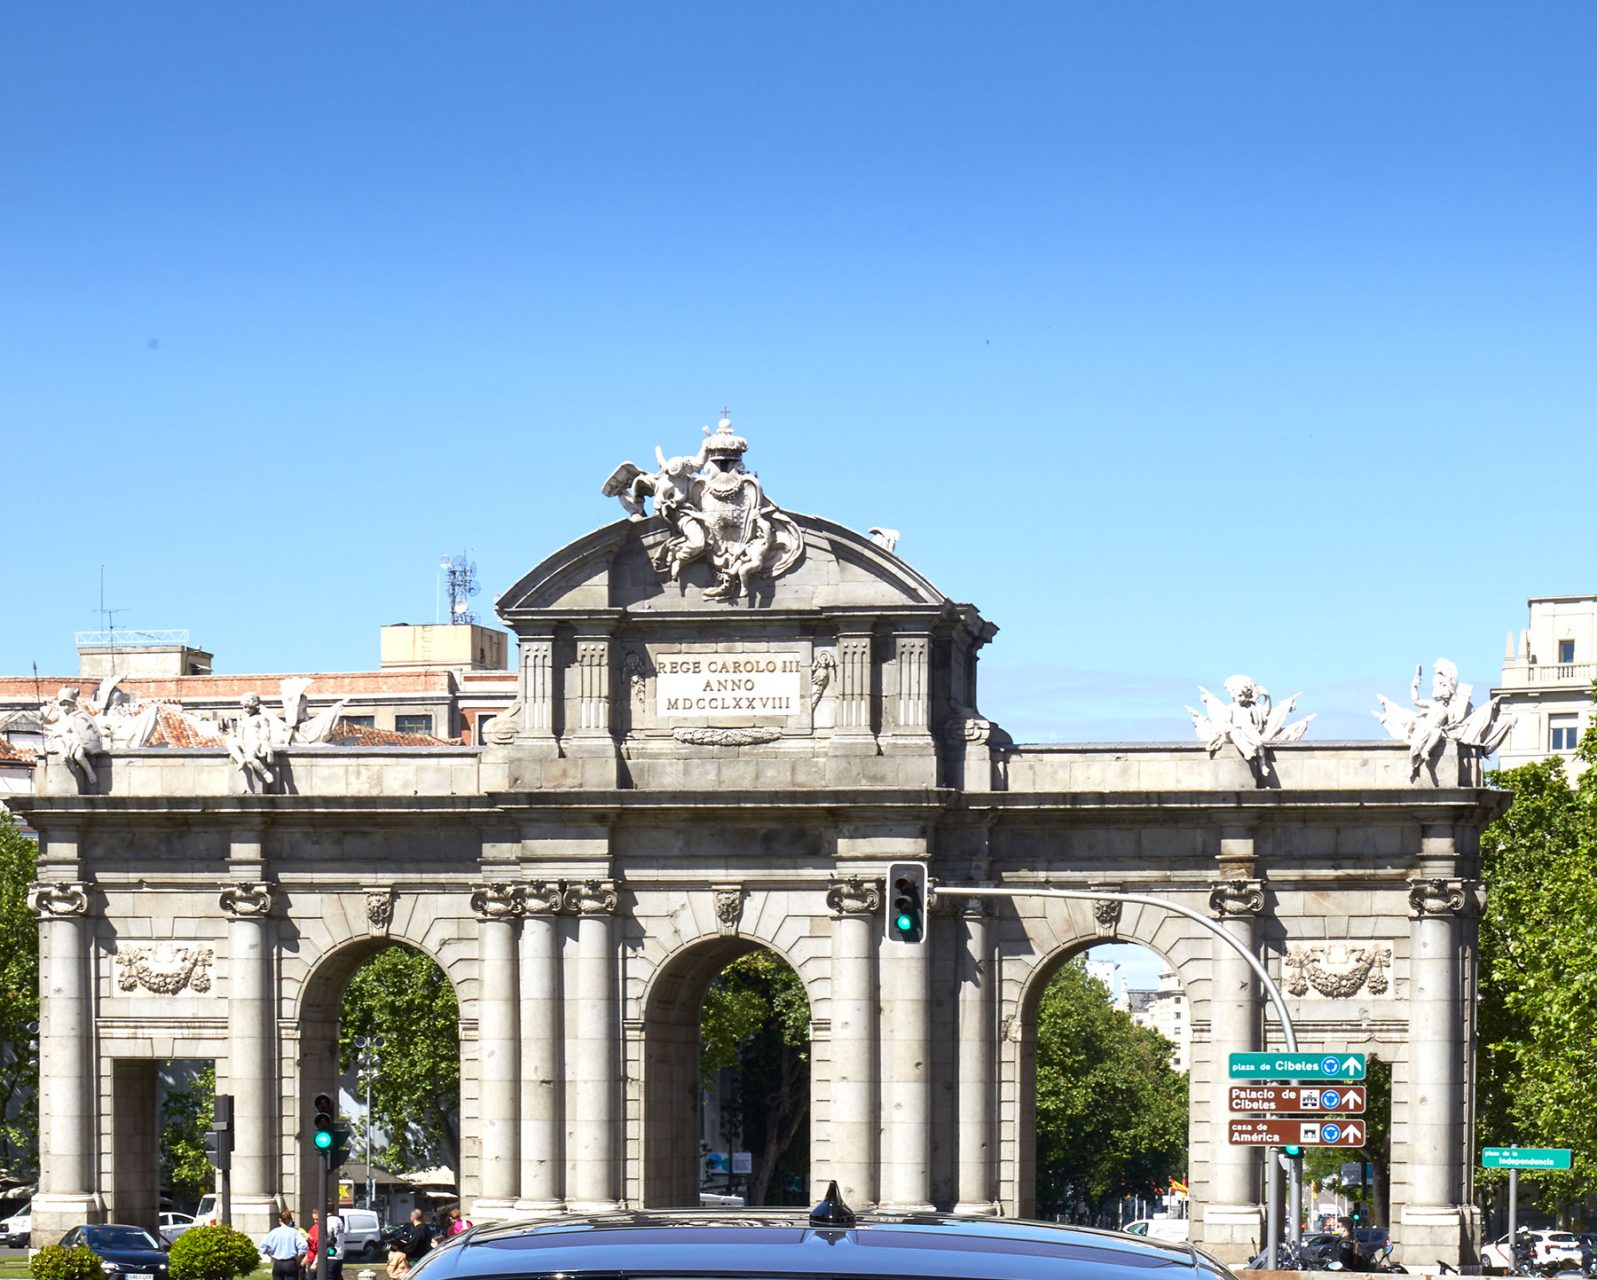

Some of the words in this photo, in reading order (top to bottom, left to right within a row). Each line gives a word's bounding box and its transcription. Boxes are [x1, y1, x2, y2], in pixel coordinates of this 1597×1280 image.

[658, 661, 702, 674] REGE
[707, 660, 777, 674] CAROLO
[781, 660, 801, 673] III
[702, 678, 755, 692] ANNO
[666, 696, 791, 710] MDCCLXXVIII
[1232, 1063, 1255, 1072] plaza
[1259, 1063, 1271, 1071] de
[1275, 1060, 1319, 1071] Cibeles
[1231, 1088, 1275, 1099] Palacio
[1281, 1088, 1297, 1099] de
[1231, 1099, 1276, 1110] Cibeles
[1256, 1123, 1268, 1131] de
[1231, 1131, 1280, 1142] América
